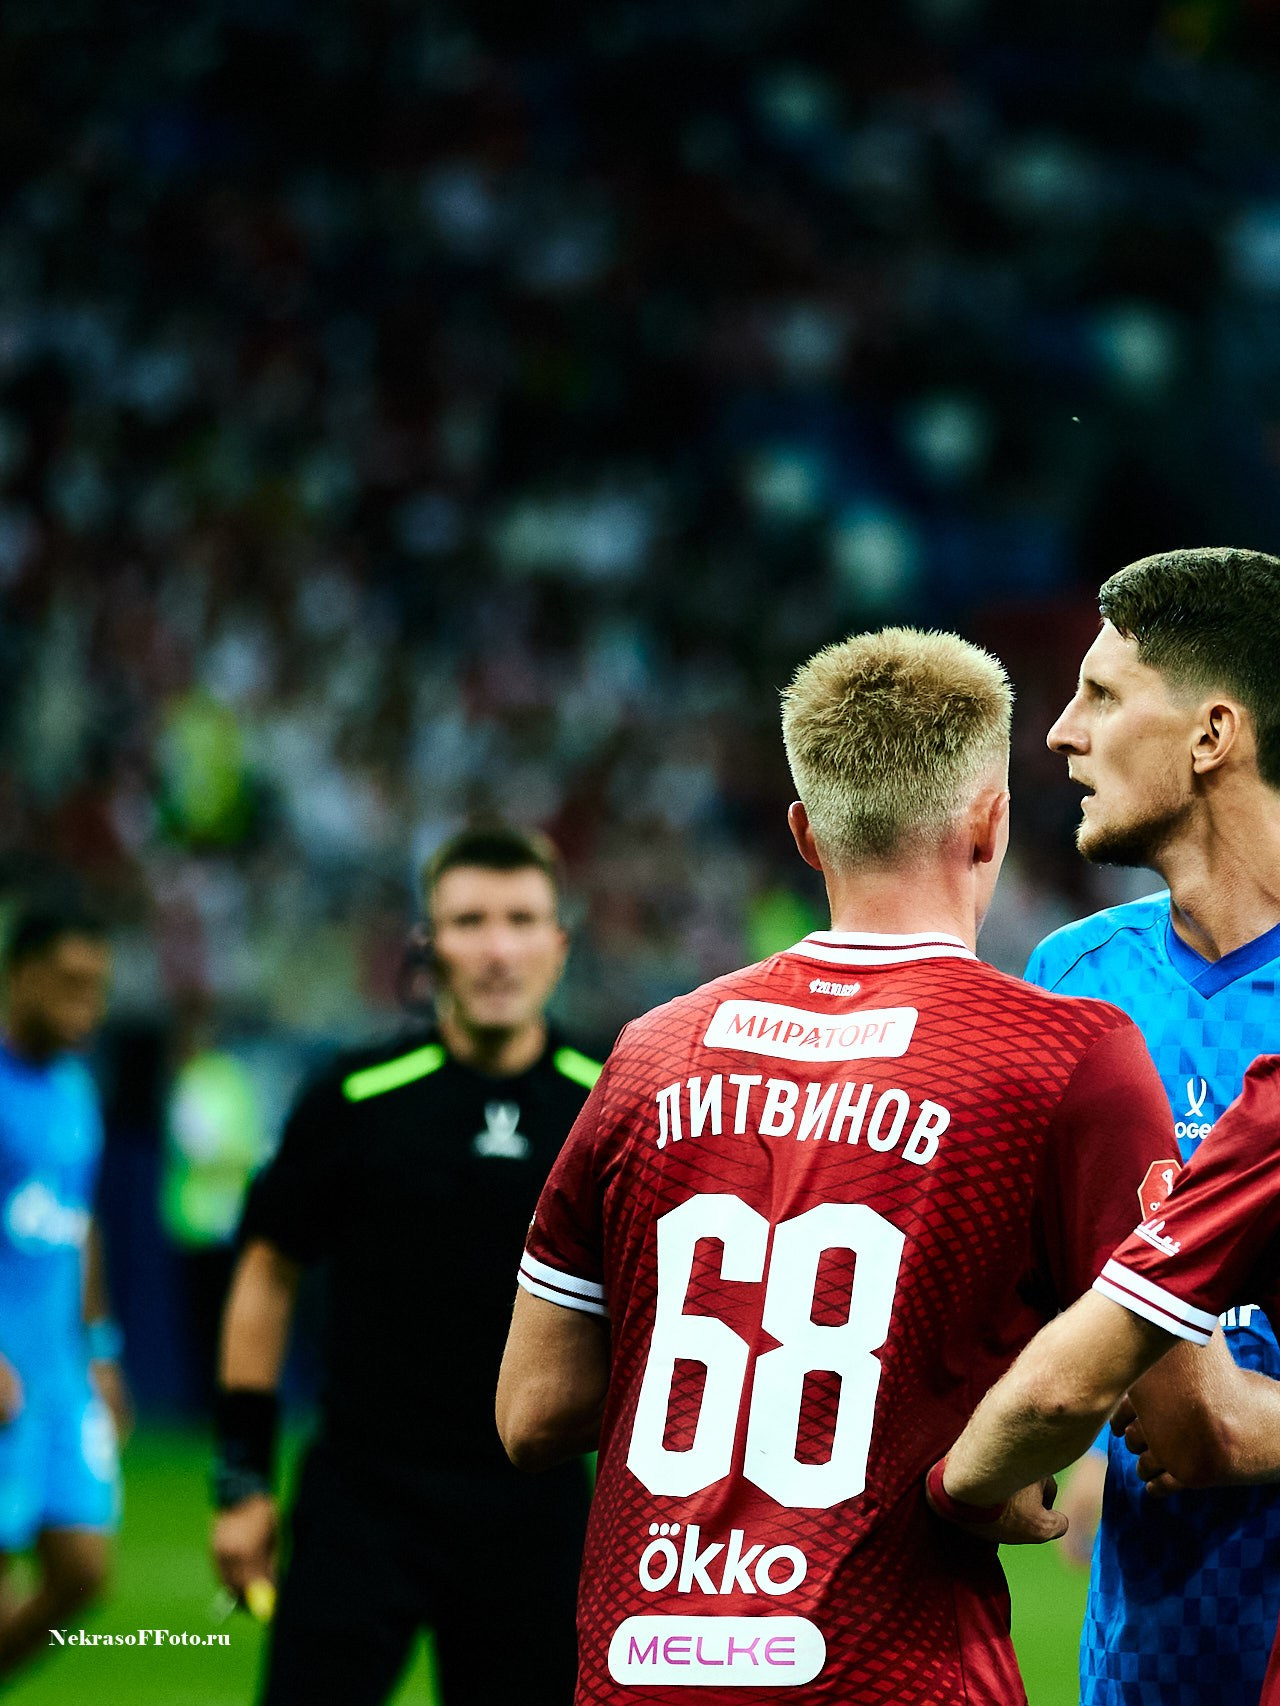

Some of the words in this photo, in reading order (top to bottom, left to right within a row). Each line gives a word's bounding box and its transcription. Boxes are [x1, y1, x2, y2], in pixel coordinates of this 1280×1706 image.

[726, 1013, 896, 1048] МИРАТОРГ
[655, 1073, 951, 1165] ЛИТВИНОВ
[625, 1193, 907, 1510] 68
[627, 1635, 796, 1666] MELKE
